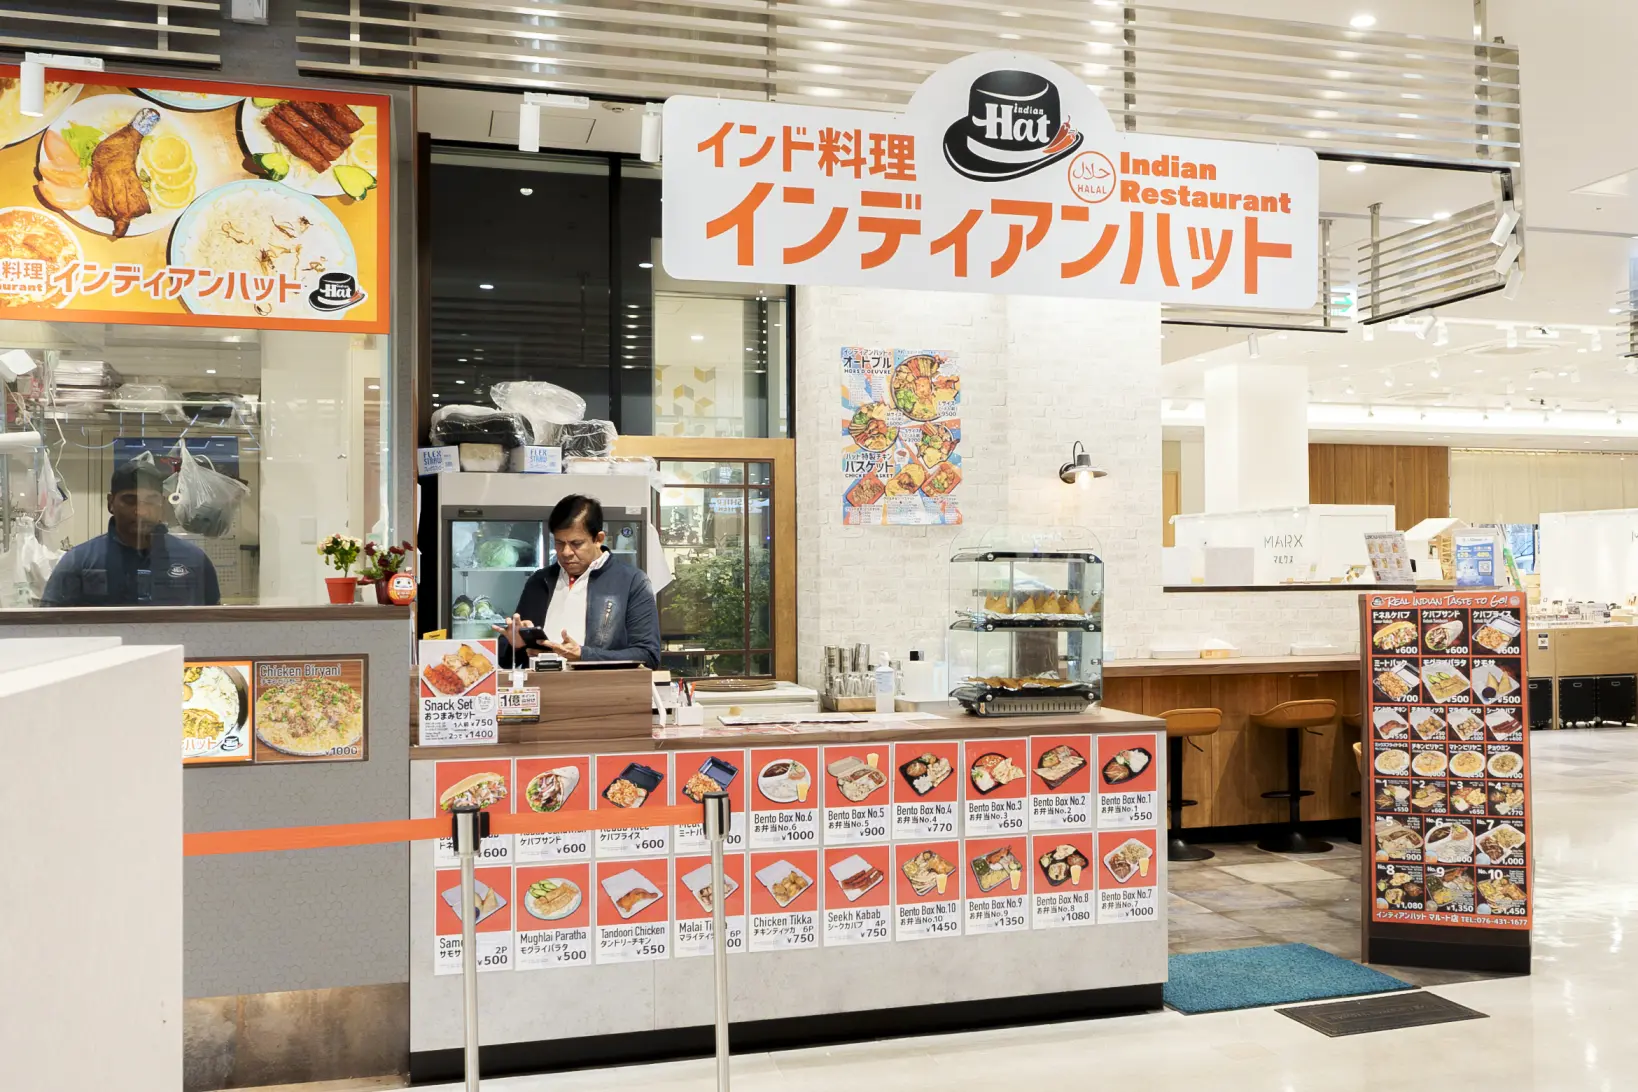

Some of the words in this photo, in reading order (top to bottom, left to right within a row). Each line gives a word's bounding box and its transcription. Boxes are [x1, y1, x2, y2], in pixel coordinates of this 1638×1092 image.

[1014, 103, 1044, 115] indian
[972, 103, 1051, 143] Hat
[697, 122, 917, 181] インド料理
[1073, 161, 1111, 180] حلال
[1120, 152, 1217, 181] Indian
[1077, 184, 1107, 194] HALAL
[1120, 180, 1291, 214] Restaurant
[706, 183, 1293, 294] インディアンハット
[2, 260, 43, 281] 料理
[0, 284, 43, 292] urant
[54, 263, 302, 304] インディアンハット
[320, 284, 352, 298] Hat
[1264, 534, 1303, 548] MARX
[260, 664, 303, 677] Chicken
[304, 663, 342, 678] Biryani
[424, 699, 455, 711] Snack
[457, 699, 473, 710] Set
[425, 712, 475, 721] おつまみセット
[471, 719, 493, 727] ¥750
[465, 730, 493, 738] ¥1400
[326, 747, 358, 755] ¥1000
[1033, 797, 1054, 807] Bento
[1055, 797, 1069, 806] Box
[1070, 796, 1085, 805] No.2
[1101, 796, 1121, 805] Bento
[1122, 795, 1135, 804] Box
[1136, 794, 1151, 803] No.1
[897, 806, 918, 815] Bento
[920, 805, 934, 815] Box
[935, 804, 952, 814] No.4
[969, 803, 989, 812] Bento
[991, 802, 1004, 811] Box
[1006, 801, 1022, 811] No.3
[1033, 807, 1071, 815] お弁当No.2
[1101, 805, 1138, 813] お弁当No.1
[754, 813, 777, 824] Bento
[779, 812, 793, 823] Box
[795, 811, 812, 822] No.6
[828, 810, 850, 820] Bento
[852, 809, 867, 819] Box
[868, 808, 884, 818] No.5
[969, 812, 1008, 821] お弁当No.3
[1062, 814, 1086, 823] ¥600
[1129, 812, 1152, 821] ¥550
[828, 820, 869, 829] お弁当No.5
[897, 816, 937, 824] お弁当No.4
[999, 819, 1023, 829] ¥650
[1376, 816, 1394, 826] No.5
[1426, 818, 1443, 828] No.6
[1476, 819, 1494, 830] No.7
[754, 824, 797, 833] お弁当No.6
[860, 827, 885, 837] ¥900
[927, 823, 953, 832] ¥770
[600, 833, 641, 841] ケバブライス
[782, 831, 814, 841] ¥1000
[520, 837, 562, 846] ケバブサンド
[636, 840, 664, 849] ¥600
[557, 844, 586, 854] ¥600
[1377, 864, 1395, 875] No.8
[1427, 866, 1445, 877] No.9
[1478, 868, 1503, 880] No.10
[1037, 897, 1057, 906] Bento
[1058, 896, 1072, 905] Box
[1073, 894, 1089, 903] No.8
[1101, 892, 1121, 901] Bento
[1123, 891, 1135, 900] Box
[1137, 889, 1152, 898] No.7
[969, 901, 989, 911] Bento
[991, 900, 1004, 909] Box
[1006, 898, 1022, 908] No.9
[1101, 901, 1138, 909] お弁当No.7
[900, 908, 920, 917] Bento
[922, 906, 934, 915] Box
[936, 903, 956, 914] No.10
[969, 910, 1008, 920] お弁当No.9
[1037, 906, 1075, 914] お弁当No.8
[1125, 907, 1153, 916] ¥1000
[828, 912, 853, 922] Seekh
[855, 909, 881, 920] Kabab
[900, 916, 943, 925] お弁当No.10
[1061, 911, 1090, 921] ¥1080
[754, 917, 787, 928] Chicken
[790, 915, 812, 925] Tikka
[828, 922, 863, 930] シークカバブ
[995, 916, 1024, 926] ¥1350
[601, 928, 633, 939] Tandoori
[635, 925, 665, 936] Chicken
[679, 922, 702, 933] Malai
[753, 928, 796, 936] チキンティッカ
[926, 922, 957, 932] ¥1450
[520, 932, 553, 946] Mughlai
[555, 930, 586, 941] Paratha
[860, 928, 887, 938] ¥750
[600, 938, 651, 948] タンドリーチキン
[787, 934, 814, 944] ¥750
[440, 950, 461, 958] サモサ
[520, 944, 568, 954] モグライパラタ
[637, 945, 665, 955] ¥550
[478, 955, 508, 965] ¥500
[558, 951, 587, 961] ¥500
